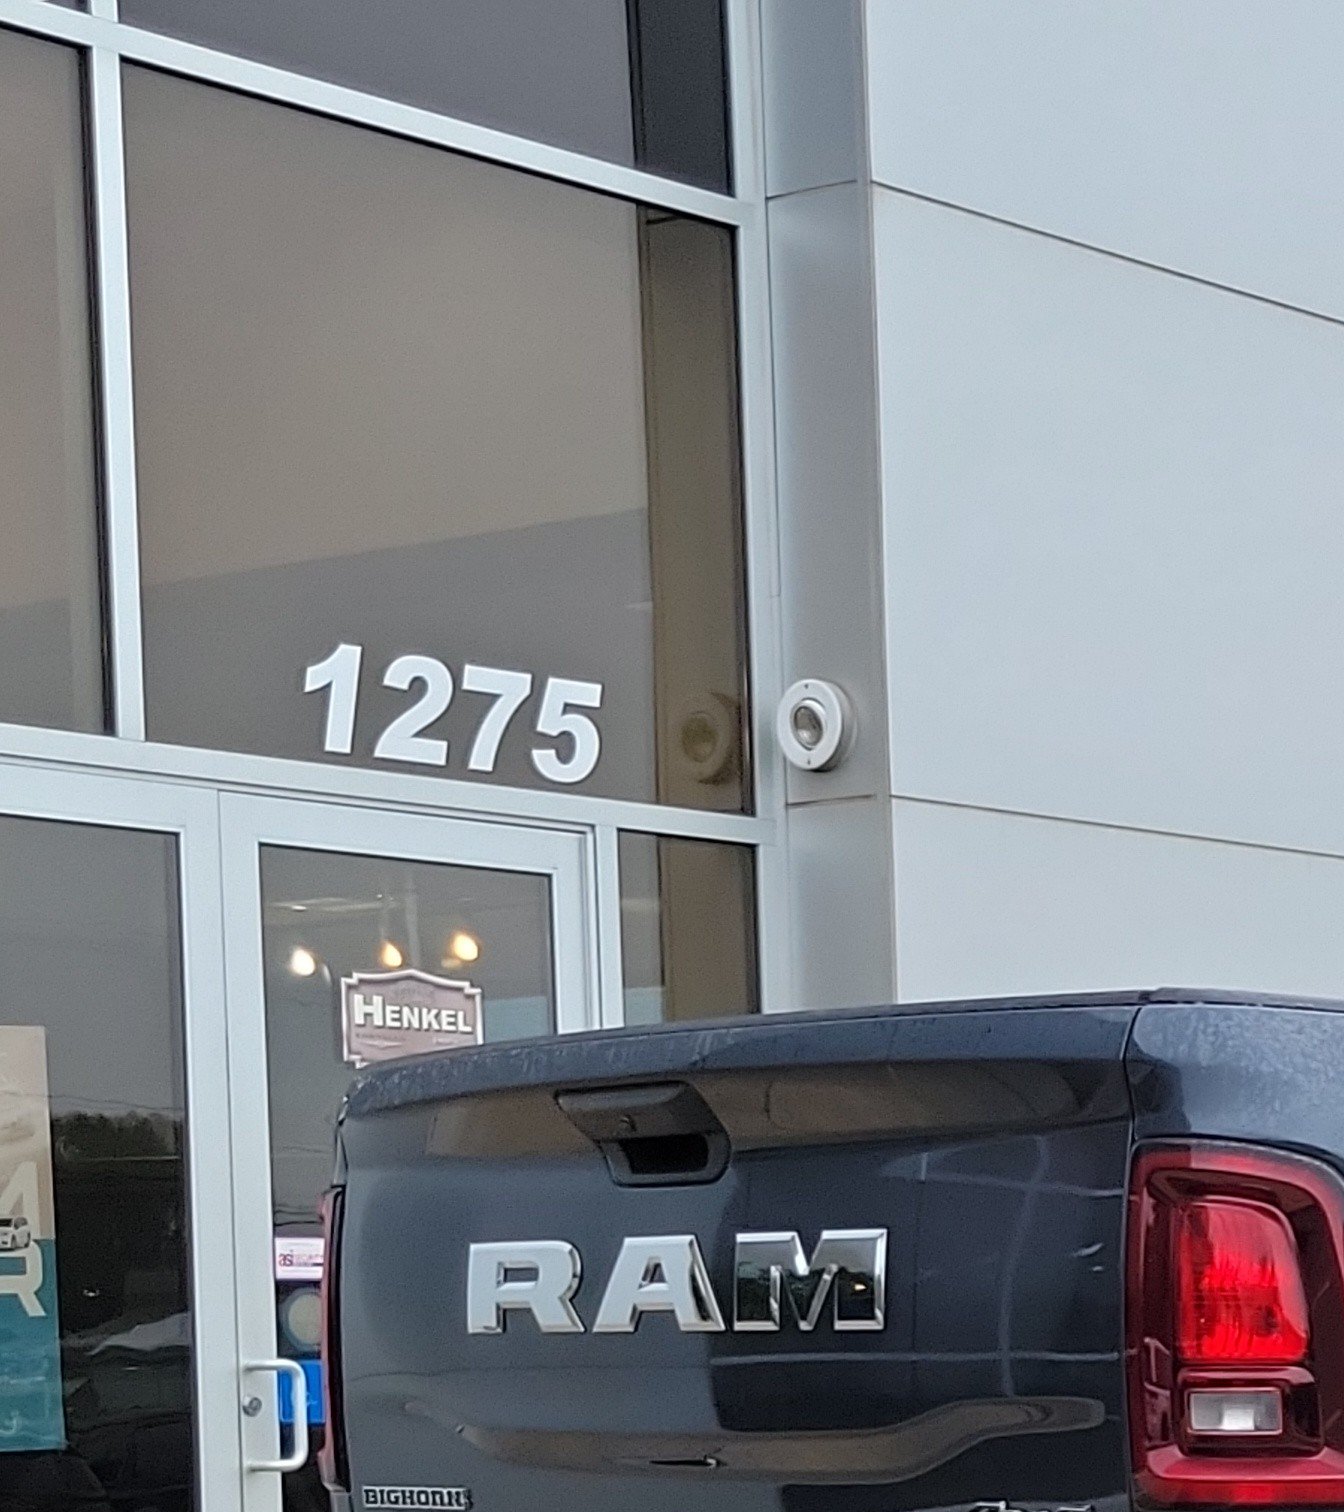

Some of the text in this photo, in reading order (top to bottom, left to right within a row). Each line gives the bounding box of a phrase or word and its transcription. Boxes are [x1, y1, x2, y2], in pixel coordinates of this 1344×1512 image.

[304, 643, 603, 783] 1275
[354, 993, 473, 1033] HENKEL
[467, 1228, 888, 1334] RAM
